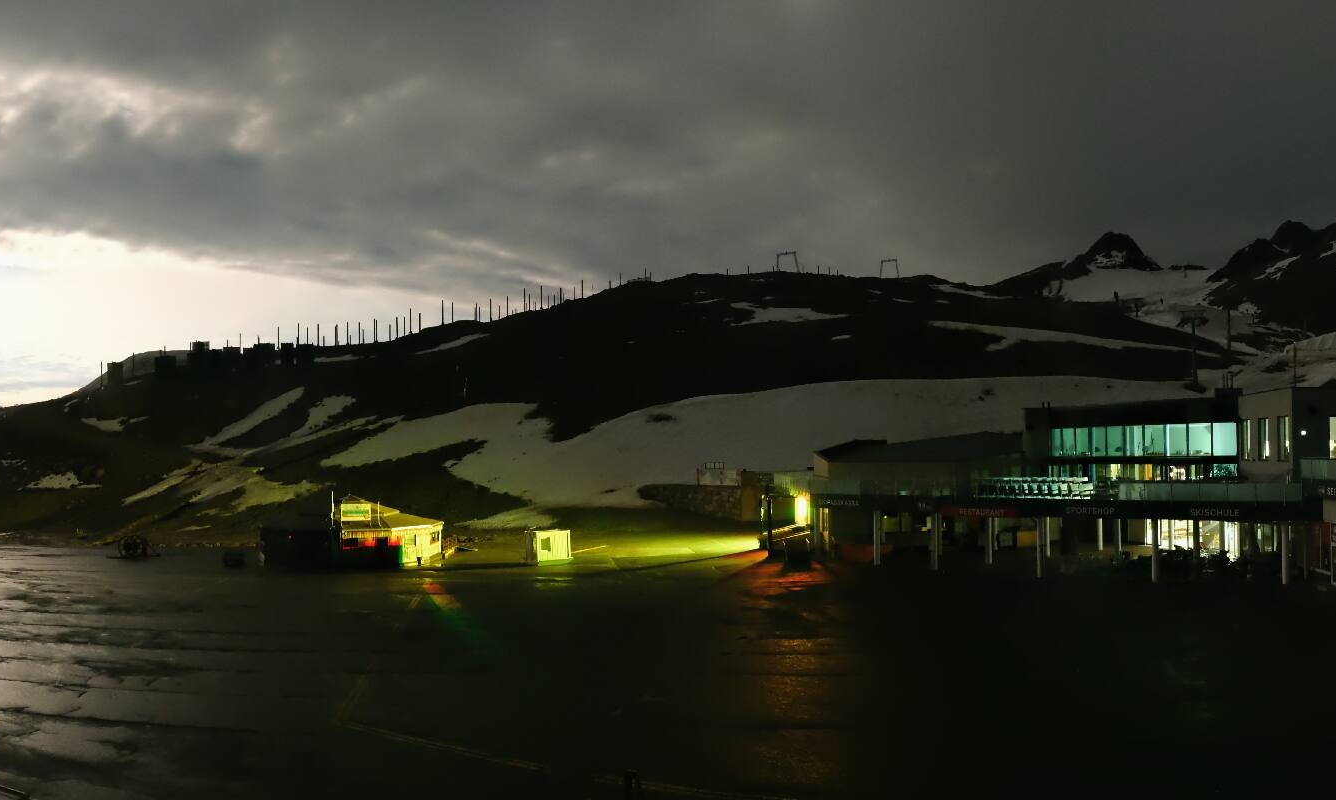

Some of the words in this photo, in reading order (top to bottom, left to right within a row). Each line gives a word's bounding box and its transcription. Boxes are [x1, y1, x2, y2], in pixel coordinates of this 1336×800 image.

[959, 507, 1006, 517] RESTAURANT
[1065, 505, 1116, 516] SPORTSHOP
[1190, 507, 1240, 517] SKISCHULE
